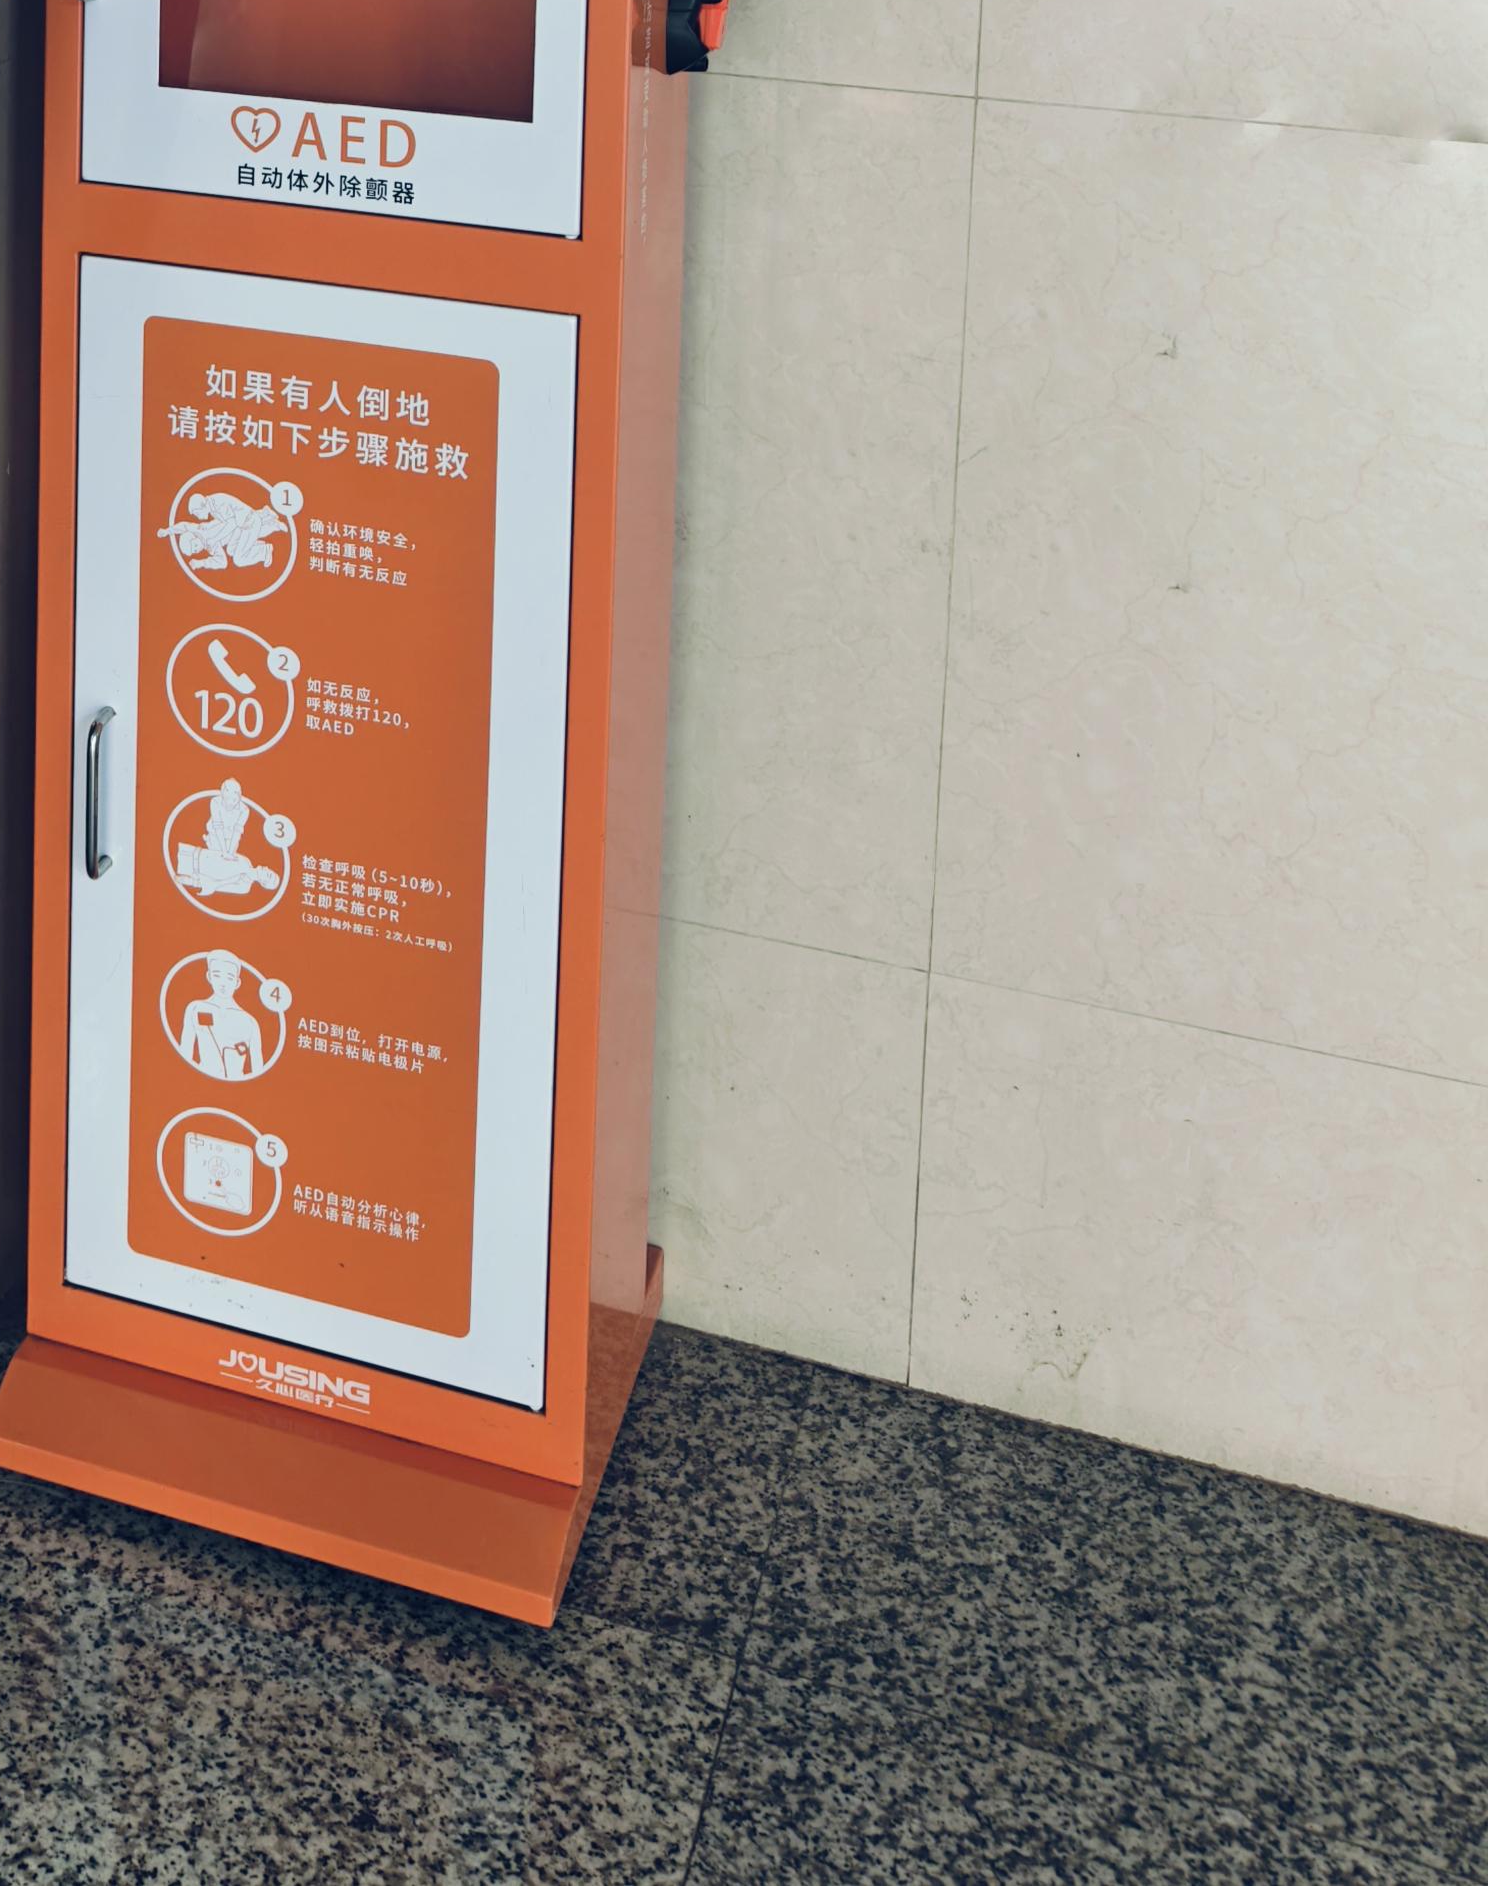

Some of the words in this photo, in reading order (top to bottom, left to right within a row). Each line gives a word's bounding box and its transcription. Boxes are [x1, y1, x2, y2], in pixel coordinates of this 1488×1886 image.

[291, 111, 417, 168] AED
[237, 163, 415, 205] 自动体外除颤器
[205, 364, 430, 427] 如果有人倒地
[167, 404, 469, 480] 请按如下步骤施救
[281, 489, 292, 507] 1
[309, 556, 408, 586] 判断有无反应
[277, 653, 289, 671] 2
[194, 689, 264, 739] 120
[306, 714, 354, 736] 取AED
[274, 821, 285, 839] 3
[301, 891, 400, 923] 立即实施CPR
[269, 986, 281, 1003] 4
[297, 1033, 425, 1074] 按图示粘贴电极片
[266, 1141, 277, 1158] 5
[293, 1199, 420, 1242] 听从语音指示操作
[218, 1349, 371, 1406] JOUSING
